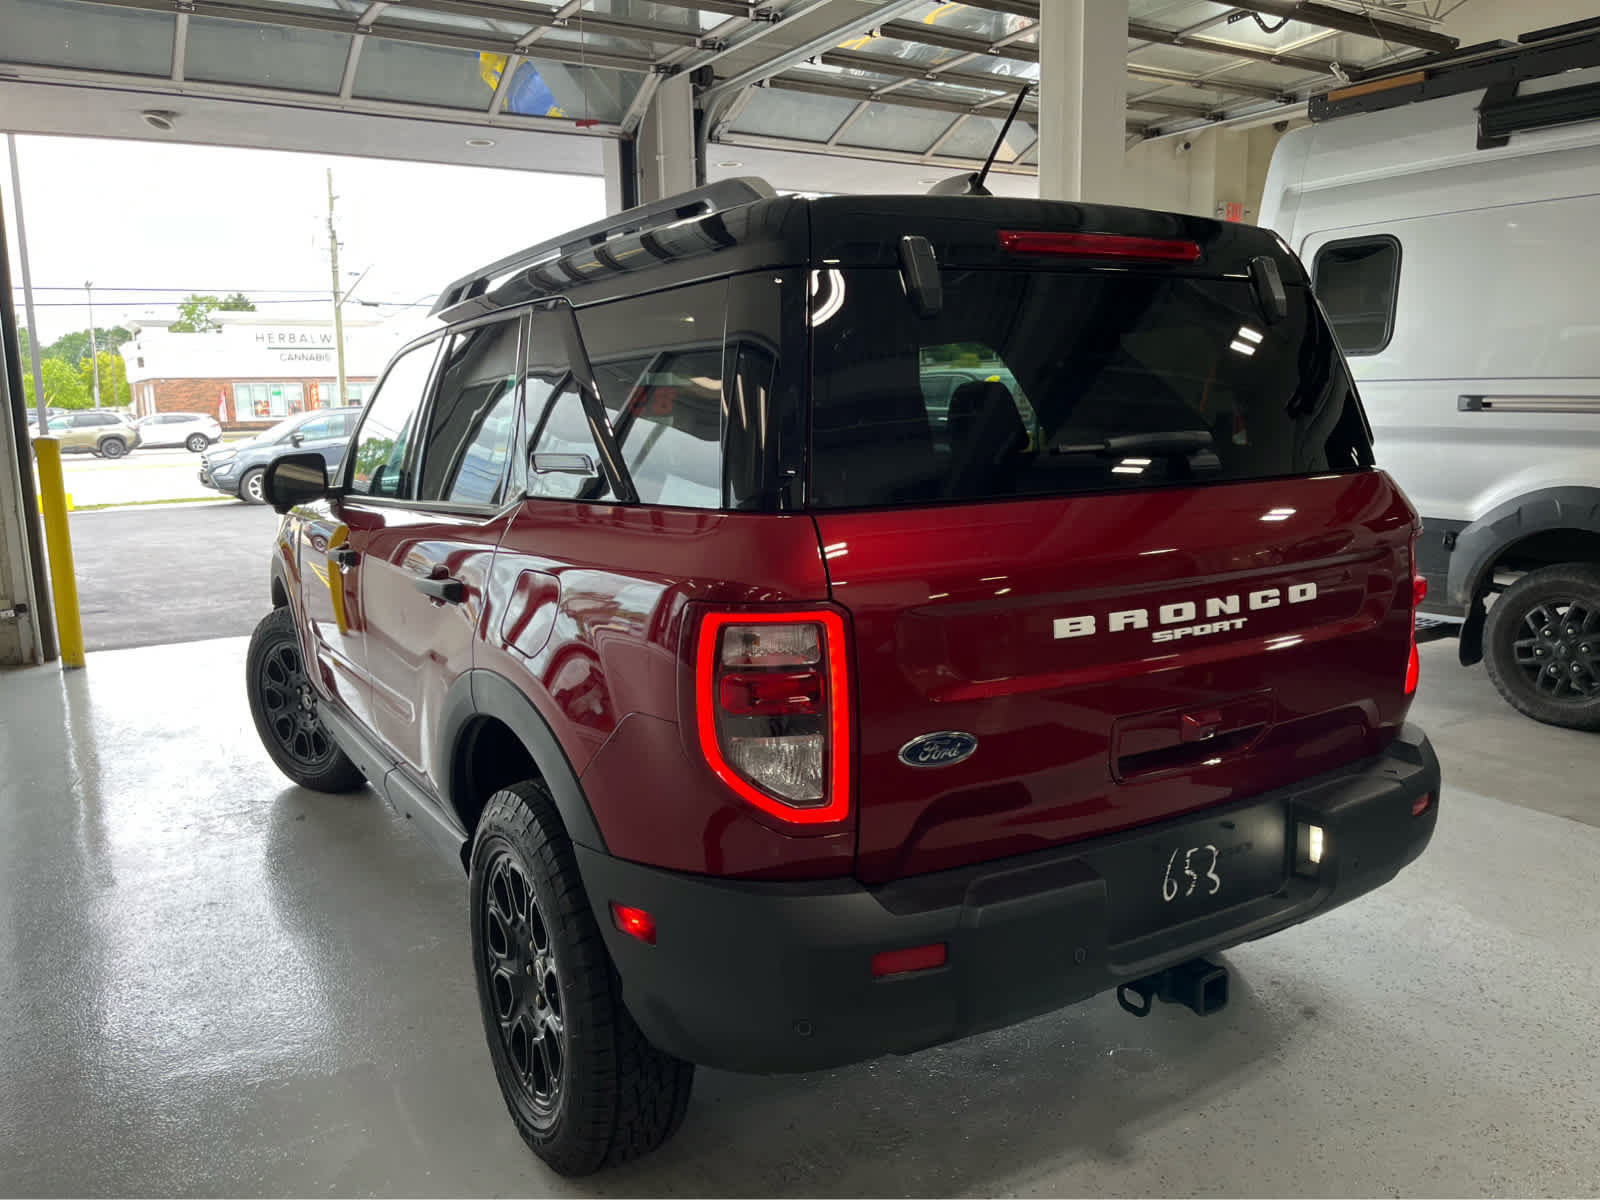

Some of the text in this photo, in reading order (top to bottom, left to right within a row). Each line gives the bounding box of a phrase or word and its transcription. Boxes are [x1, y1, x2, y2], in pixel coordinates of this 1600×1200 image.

[279, 352, 331, 362] CANNABIS
[1053, 582, 1317, 640] BRONCO
[1151, 617, 1248, 643] SPORT
[918, 741, 961, 762] Ford
[1162, 844, 1220, 902] 653
